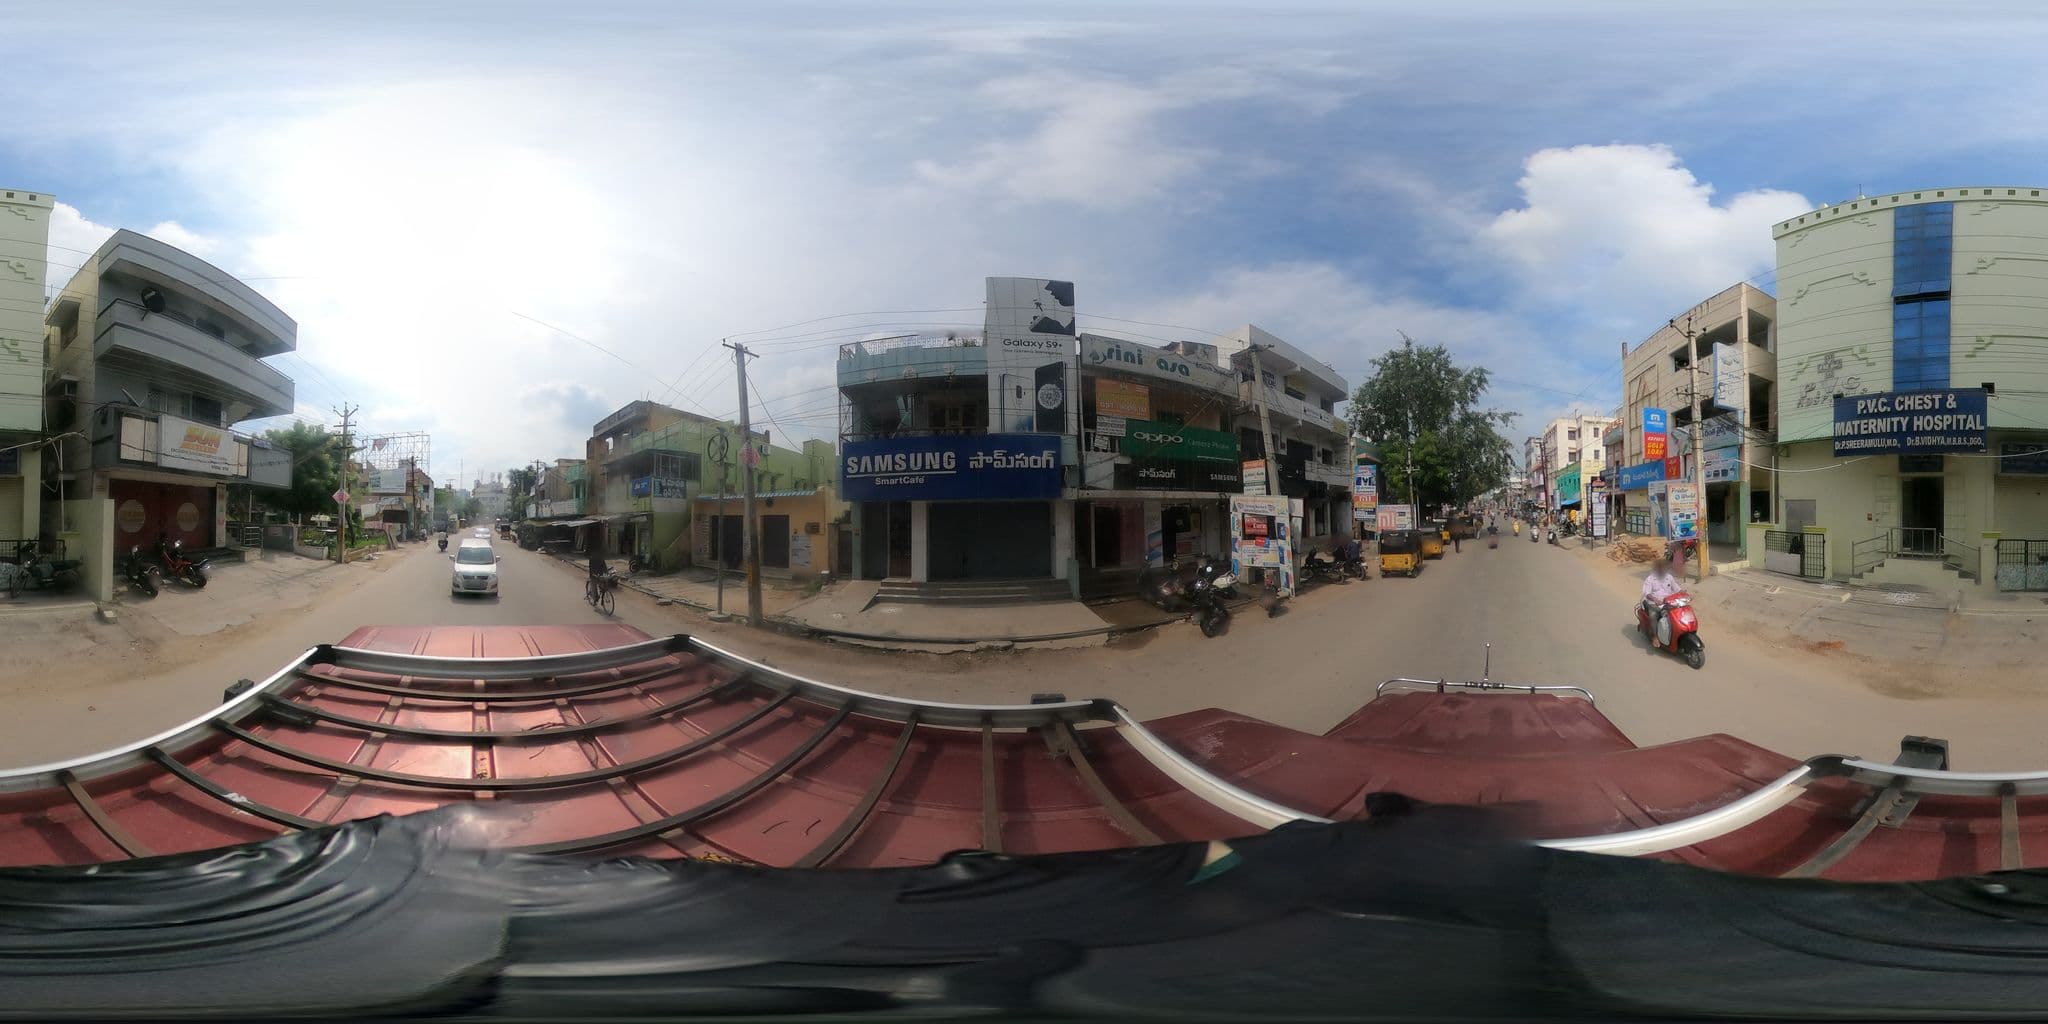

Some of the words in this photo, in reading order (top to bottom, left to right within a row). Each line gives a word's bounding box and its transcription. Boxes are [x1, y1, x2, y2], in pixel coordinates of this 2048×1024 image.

[1003, 338, 1043, 349] Galaxy
[1046, 340, 1063, 348] S9+
[1857, 397, 1891, 415] P.V.C.
[1895, 394, 1943, 412] CHEST
[1946, 393, 1957, 409] &
[1835, 416, 1910, 437] MATERNITY
[1913, 414, 1985, 433] HOSPITAL
[847, 452, 956, 474] SAMSUNG
[1210, 473, 1238, 482] SAMSUNG
